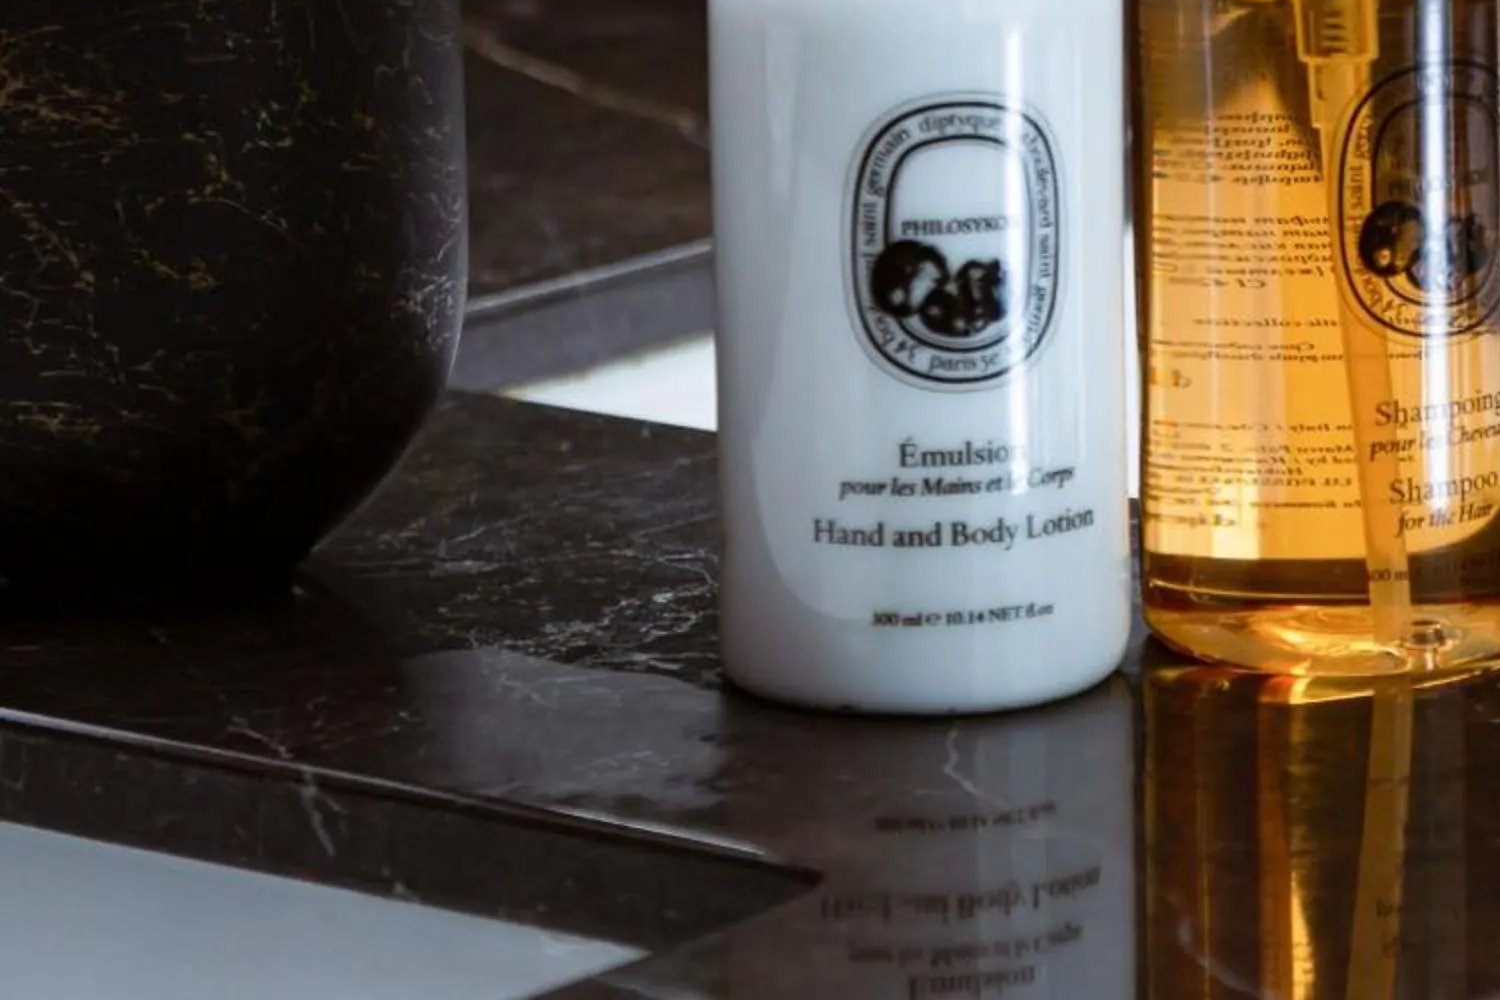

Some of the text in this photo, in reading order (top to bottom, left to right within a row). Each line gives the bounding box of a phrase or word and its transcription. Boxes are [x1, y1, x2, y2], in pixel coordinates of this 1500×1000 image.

[862, 203, 877, 246] saint
[901, 214, 1013, 237] PHILOSYKO
[899, 437, 1025, 468] Émulsio
[1369, 437, 1416, 461] pour
[839, 479, 886, 499] pour
[890, 477, 915, 497] les
[920, 477, 982, 496] Mains
[1027, 466, 1075, 490] Corps
[1389, 471, 1499, 506] Shampoo
[813, 507, 1094, 550] Hand and Body Lotion
[1396, 502, 1494, 538] for the Hair
[987, 605, 1023, 622] NET
